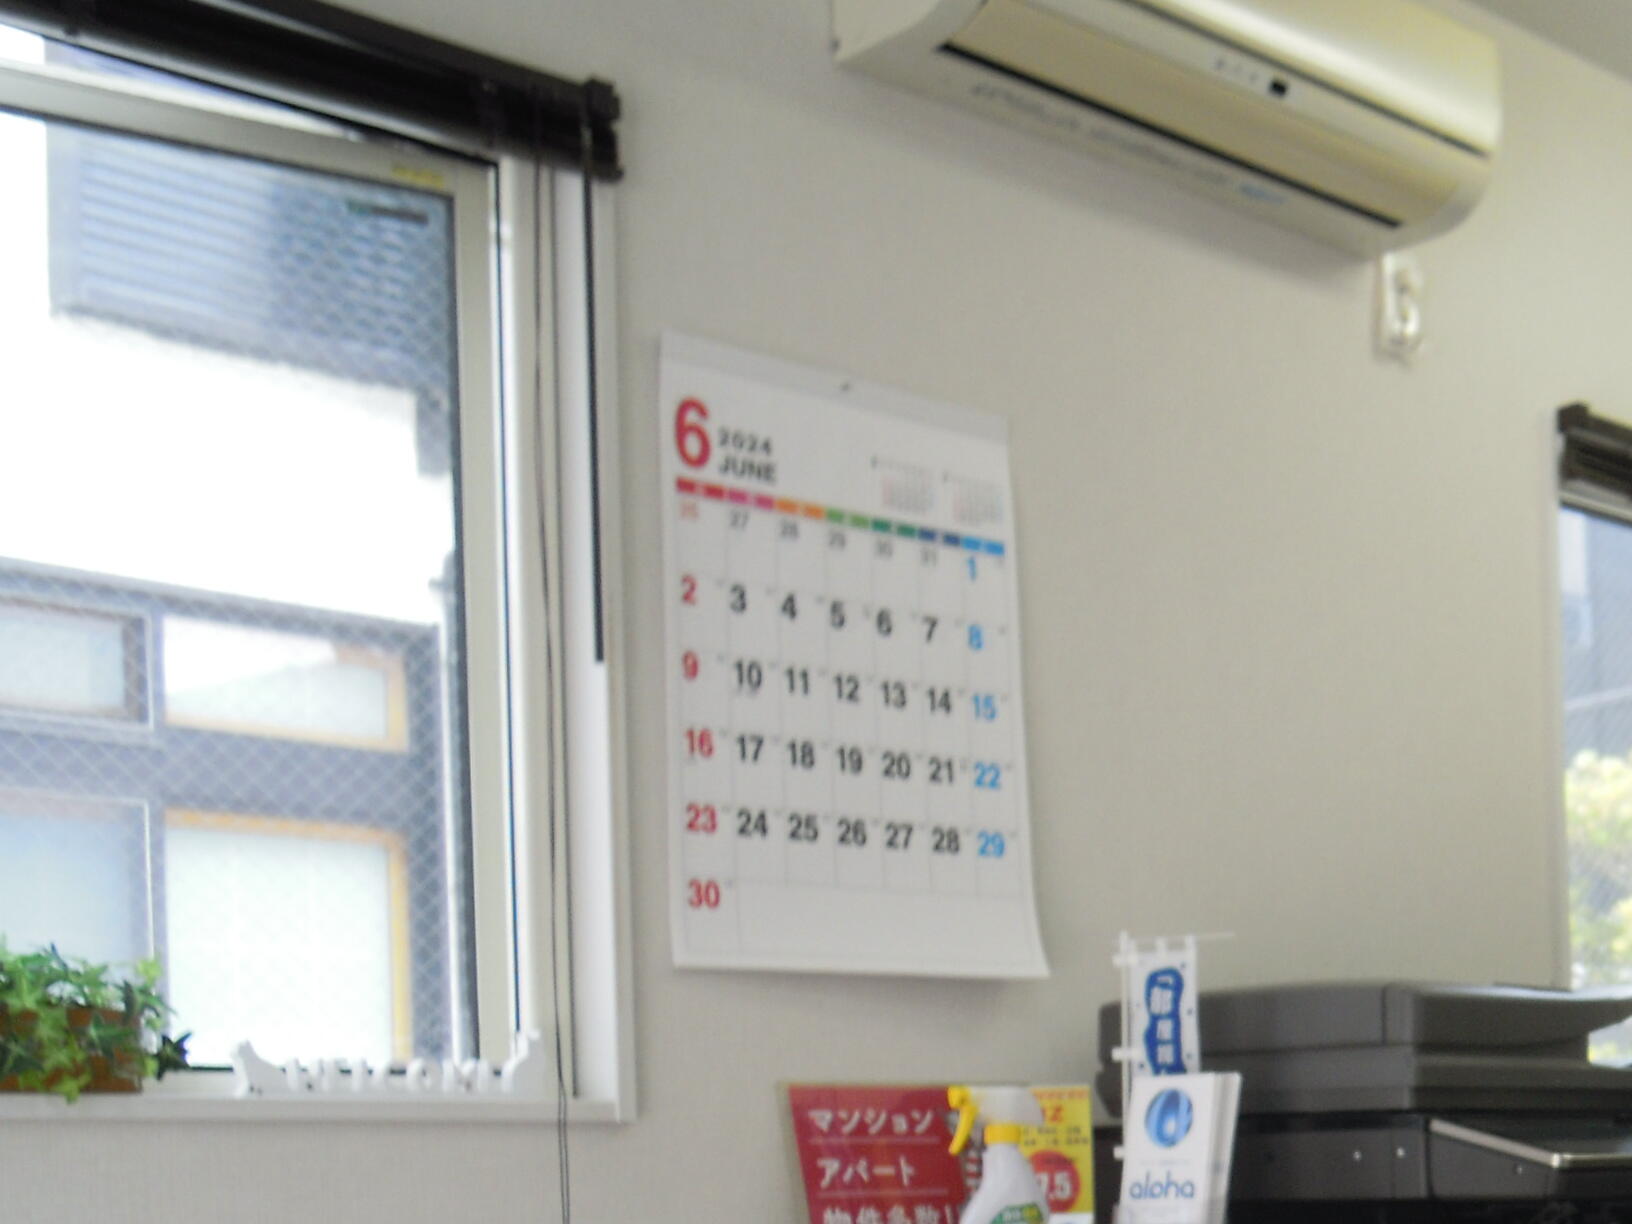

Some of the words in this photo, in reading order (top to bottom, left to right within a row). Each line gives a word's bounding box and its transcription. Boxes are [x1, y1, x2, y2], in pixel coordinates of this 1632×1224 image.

[674, 396, 712, 468] 6
[718, 427, 773, 456] 2024
[718, 455, 776, 484] JUNE
[681, 575, 696, 604] 2
[730, 584, 747, 613] 3
[781, 593, 797, 620] 4
[830, 601, 845, 628] 5
[876, 608, 892, 636] 6
[922, 616, 939, 642] 7
[968, 624, 983, 650] 8
[682, 651, 698, 680] 9
[734, 660, 762, 692] 10
[786, 667, 810, 695] 11
[834, 674, 859, 702] 12
[882, 681, 907, 709] 13
[928, 688, 952, 714] 14
[973, 694, 996, 720] 15
[685, 728, 714, 757] 16
[736, 734, 764, 762] 17
[788, 741, 815, 769] 18
[837, 747, 863, 774] 19
[882, 752, 911, 779] 20
[929, 757, 954, 783] 21
[974, 762, 1000, 789] 22
[686, 803, 717, 833] 23
[737, 809, 768, 837] 24
[788, 814, 819, 842] 25
[838, 819, 867, 846] 26
[886, 823, 914, 849] 27
[932, 827, 960, 854] 28
[978, 831, 1005, 857] 29
[688, 880, 721, 908] 30
[807, 1108, 933, 1135] マンション
[817, 1155, 915, 1188] アパート
[1129, 1171, 1196, 1200] aloha
